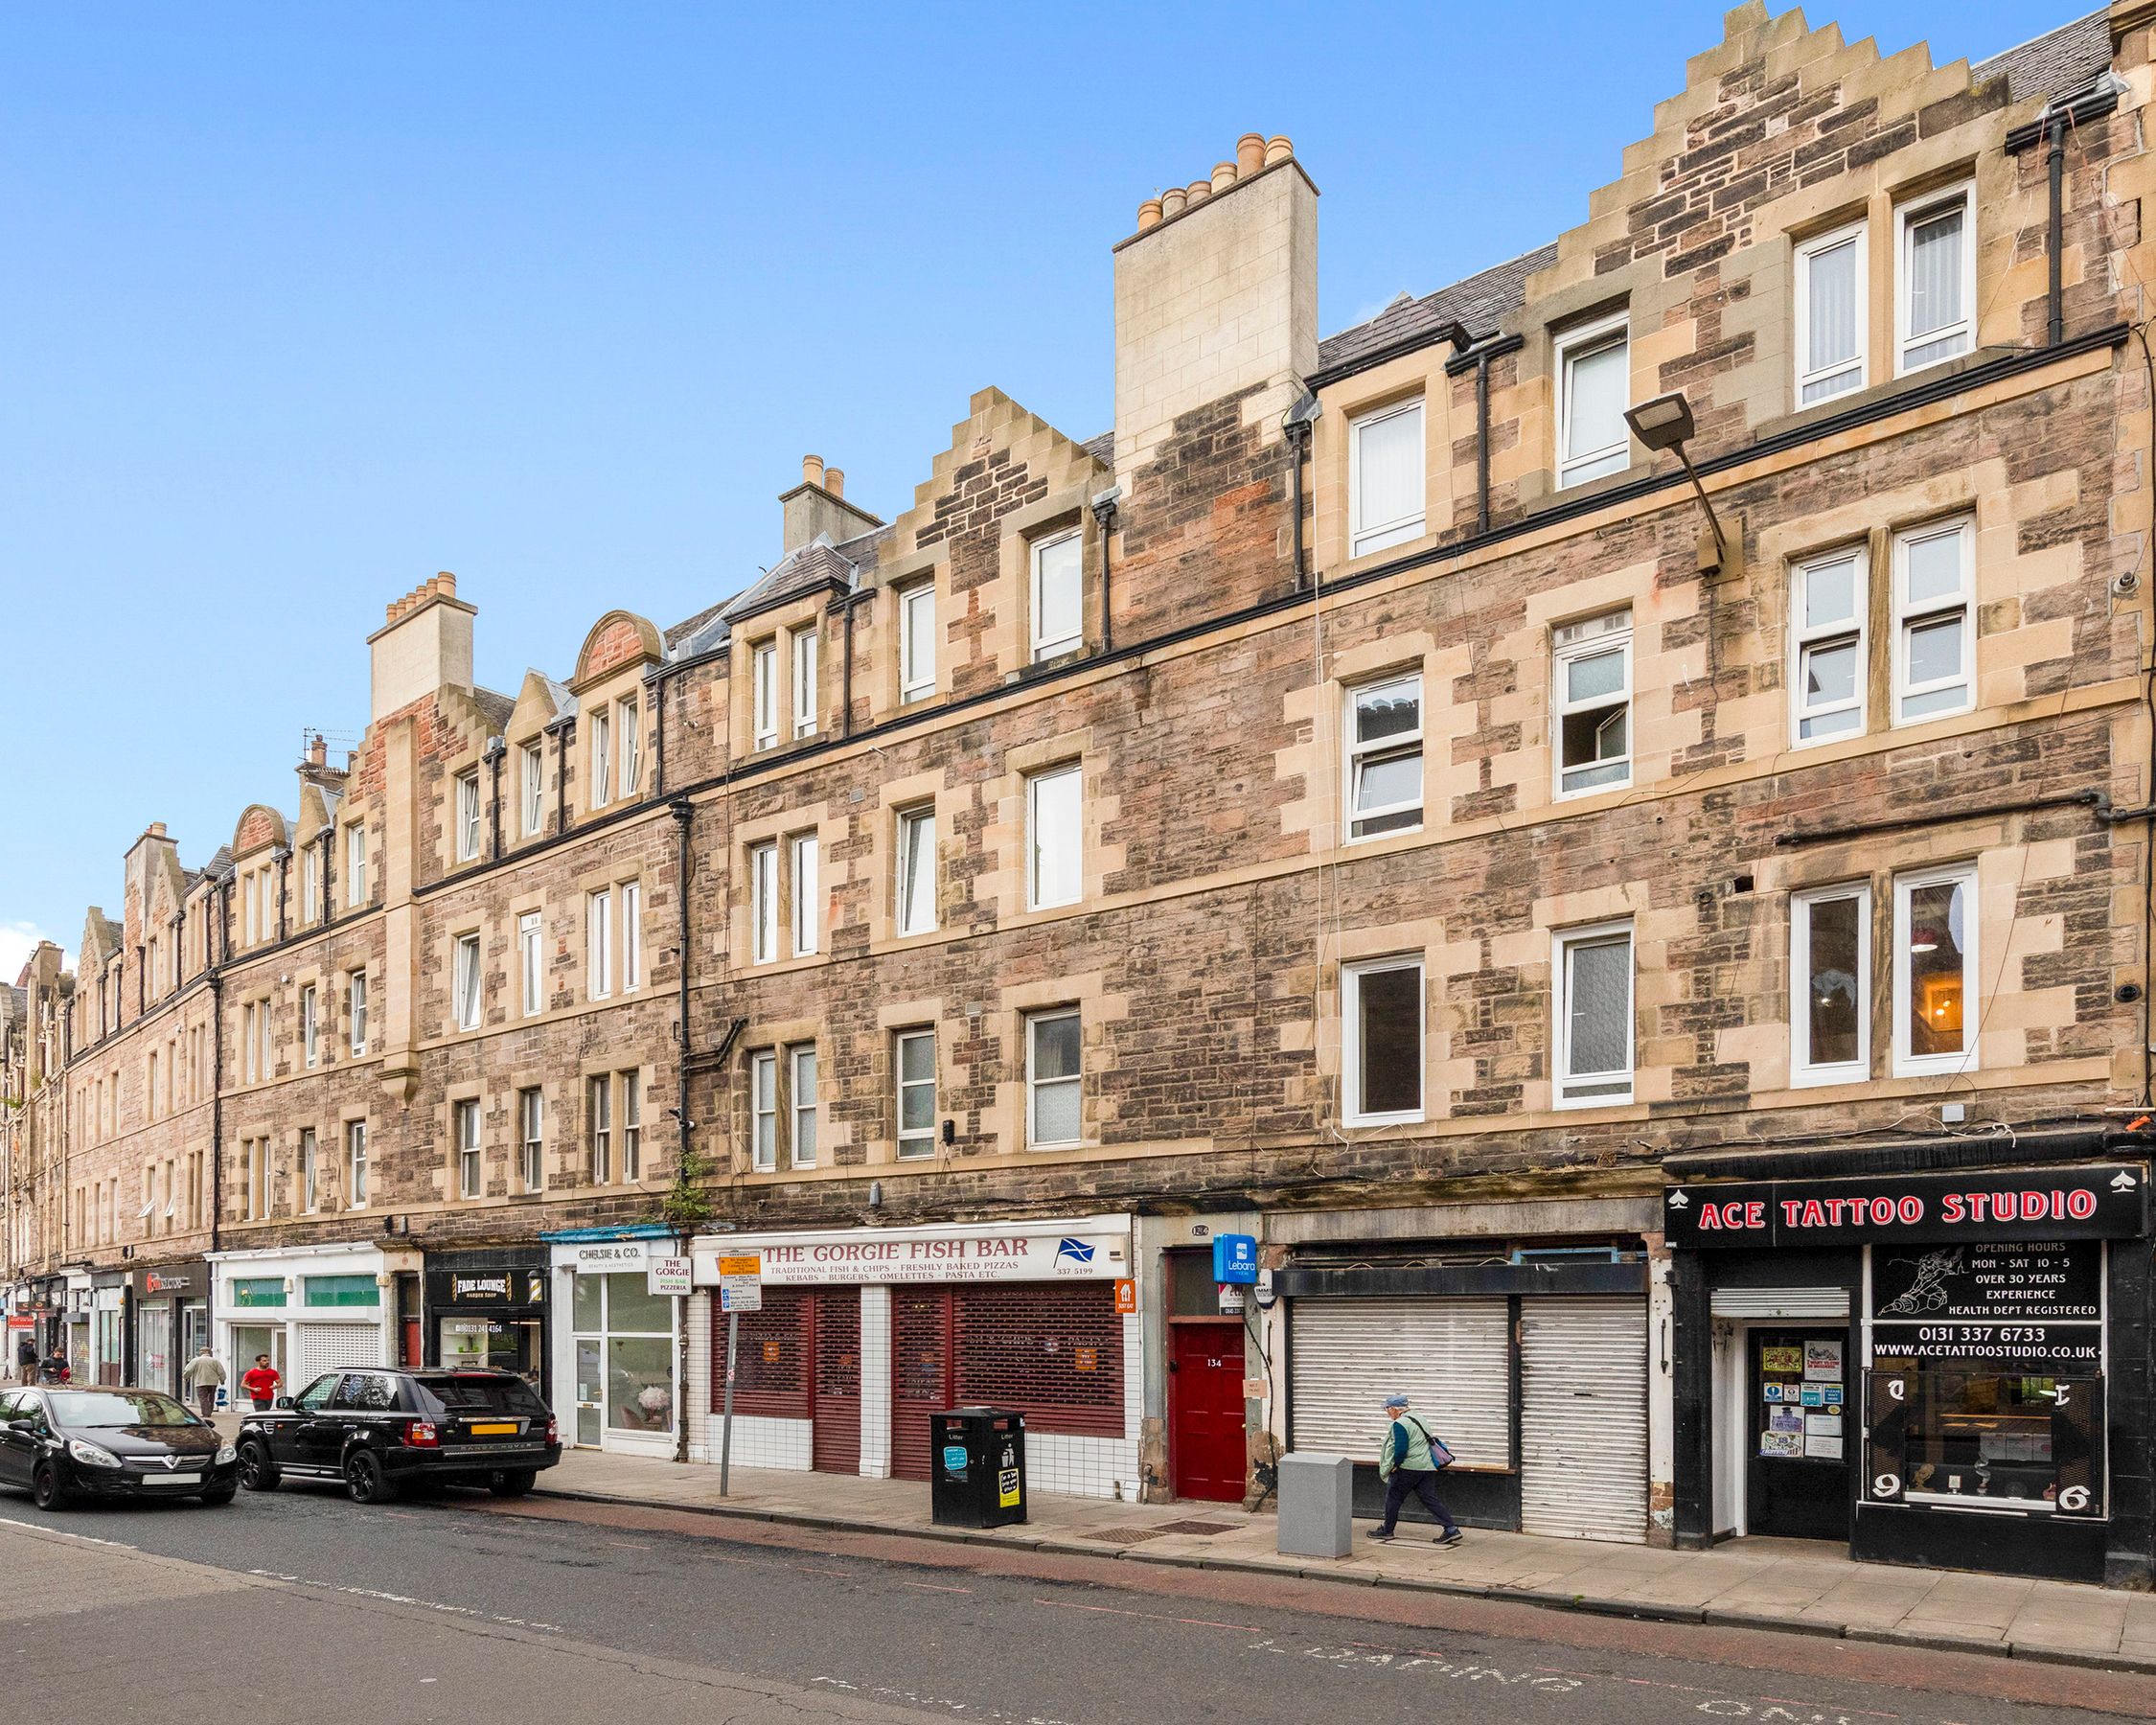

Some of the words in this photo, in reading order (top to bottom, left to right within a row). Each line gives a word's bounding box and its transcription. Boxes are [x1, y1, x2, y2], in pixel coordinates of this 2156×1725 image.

[1698, 1201, 1765, 1230] ACE
[1780, 1196, 1924, 1228] TATTOO
[1941, 1188, 2097, 1223] STUDIO
[579, 1249, 612, 1260] CHELSIE
[613, 1249, 621, 1259] &
[623, 1247, 641, 1258] CO.
[763, 1247, 805, 1263] THE
[814, 1243, 900, 1262] GORGIE
[909, 1239, 966, 1260] FISH
[976, 1238, 1029, 1258] BAR
[1975, 1243, 2024, 1254] OPENING
[2028, 1242, 2066, 1252] HOURS
[664, 1259, 681, 1268] THE
[770, 1266, 826, 1275] TRADITIONAL
[830, 1265, 849, 1274] FISH
[862, 1264, 890, 1273] CHIPS
[900, 1263, 943, 1272] FRESHLY
[946, 1261, 980, 1271] BAKED
[984, 1260, 1019, 1270] PIZZAS
[1227, 1260, 1255, 1271] Lebara
[1971, 1259, 1996, 1269] MON
[2008, 1258, 2029, 1268] SAT
[2037, 1258, 2050, 1268] 10
[2062, 1258, 2071, 1267] 5
[655, 1268, 690, 1276] GORGIE
[786, 1274, 819, 1282] KEBABS
[829, 1273, 870, 1281] BURGERS
[880, 1272, 934, 1280] OMELETTES
[945, 1271, 975, 1279] PASTA
[1975, 1275, 2005, 1284] OVER
[2008, 1275, 2024, 1283] 30
[2028, 1274, 2066, 1283] YEARS
[457, 1279, 475, 1294] FADE
[477, 1278, 506, 1293] LOUNGE
[1986, 1290, 2055, 1300] EXPERIENCE
[1948, 1306, 1989, 1316] HEALTH
[1993, 1306, 2022, 1315] DEPT
[2026, 1305, 2097, 1315] REGISTERED
[1919, 1326, 1954, 1342] 0131
[1961, 1327, 1992, 1342] 337
[2000, 1327, 2046, 1342] 6733
[1874, 1344, 2097, 1358] WWW.ACETATTOOSTUDIO.CO.UK
[1207, 1358, 1222, 1368] 134
